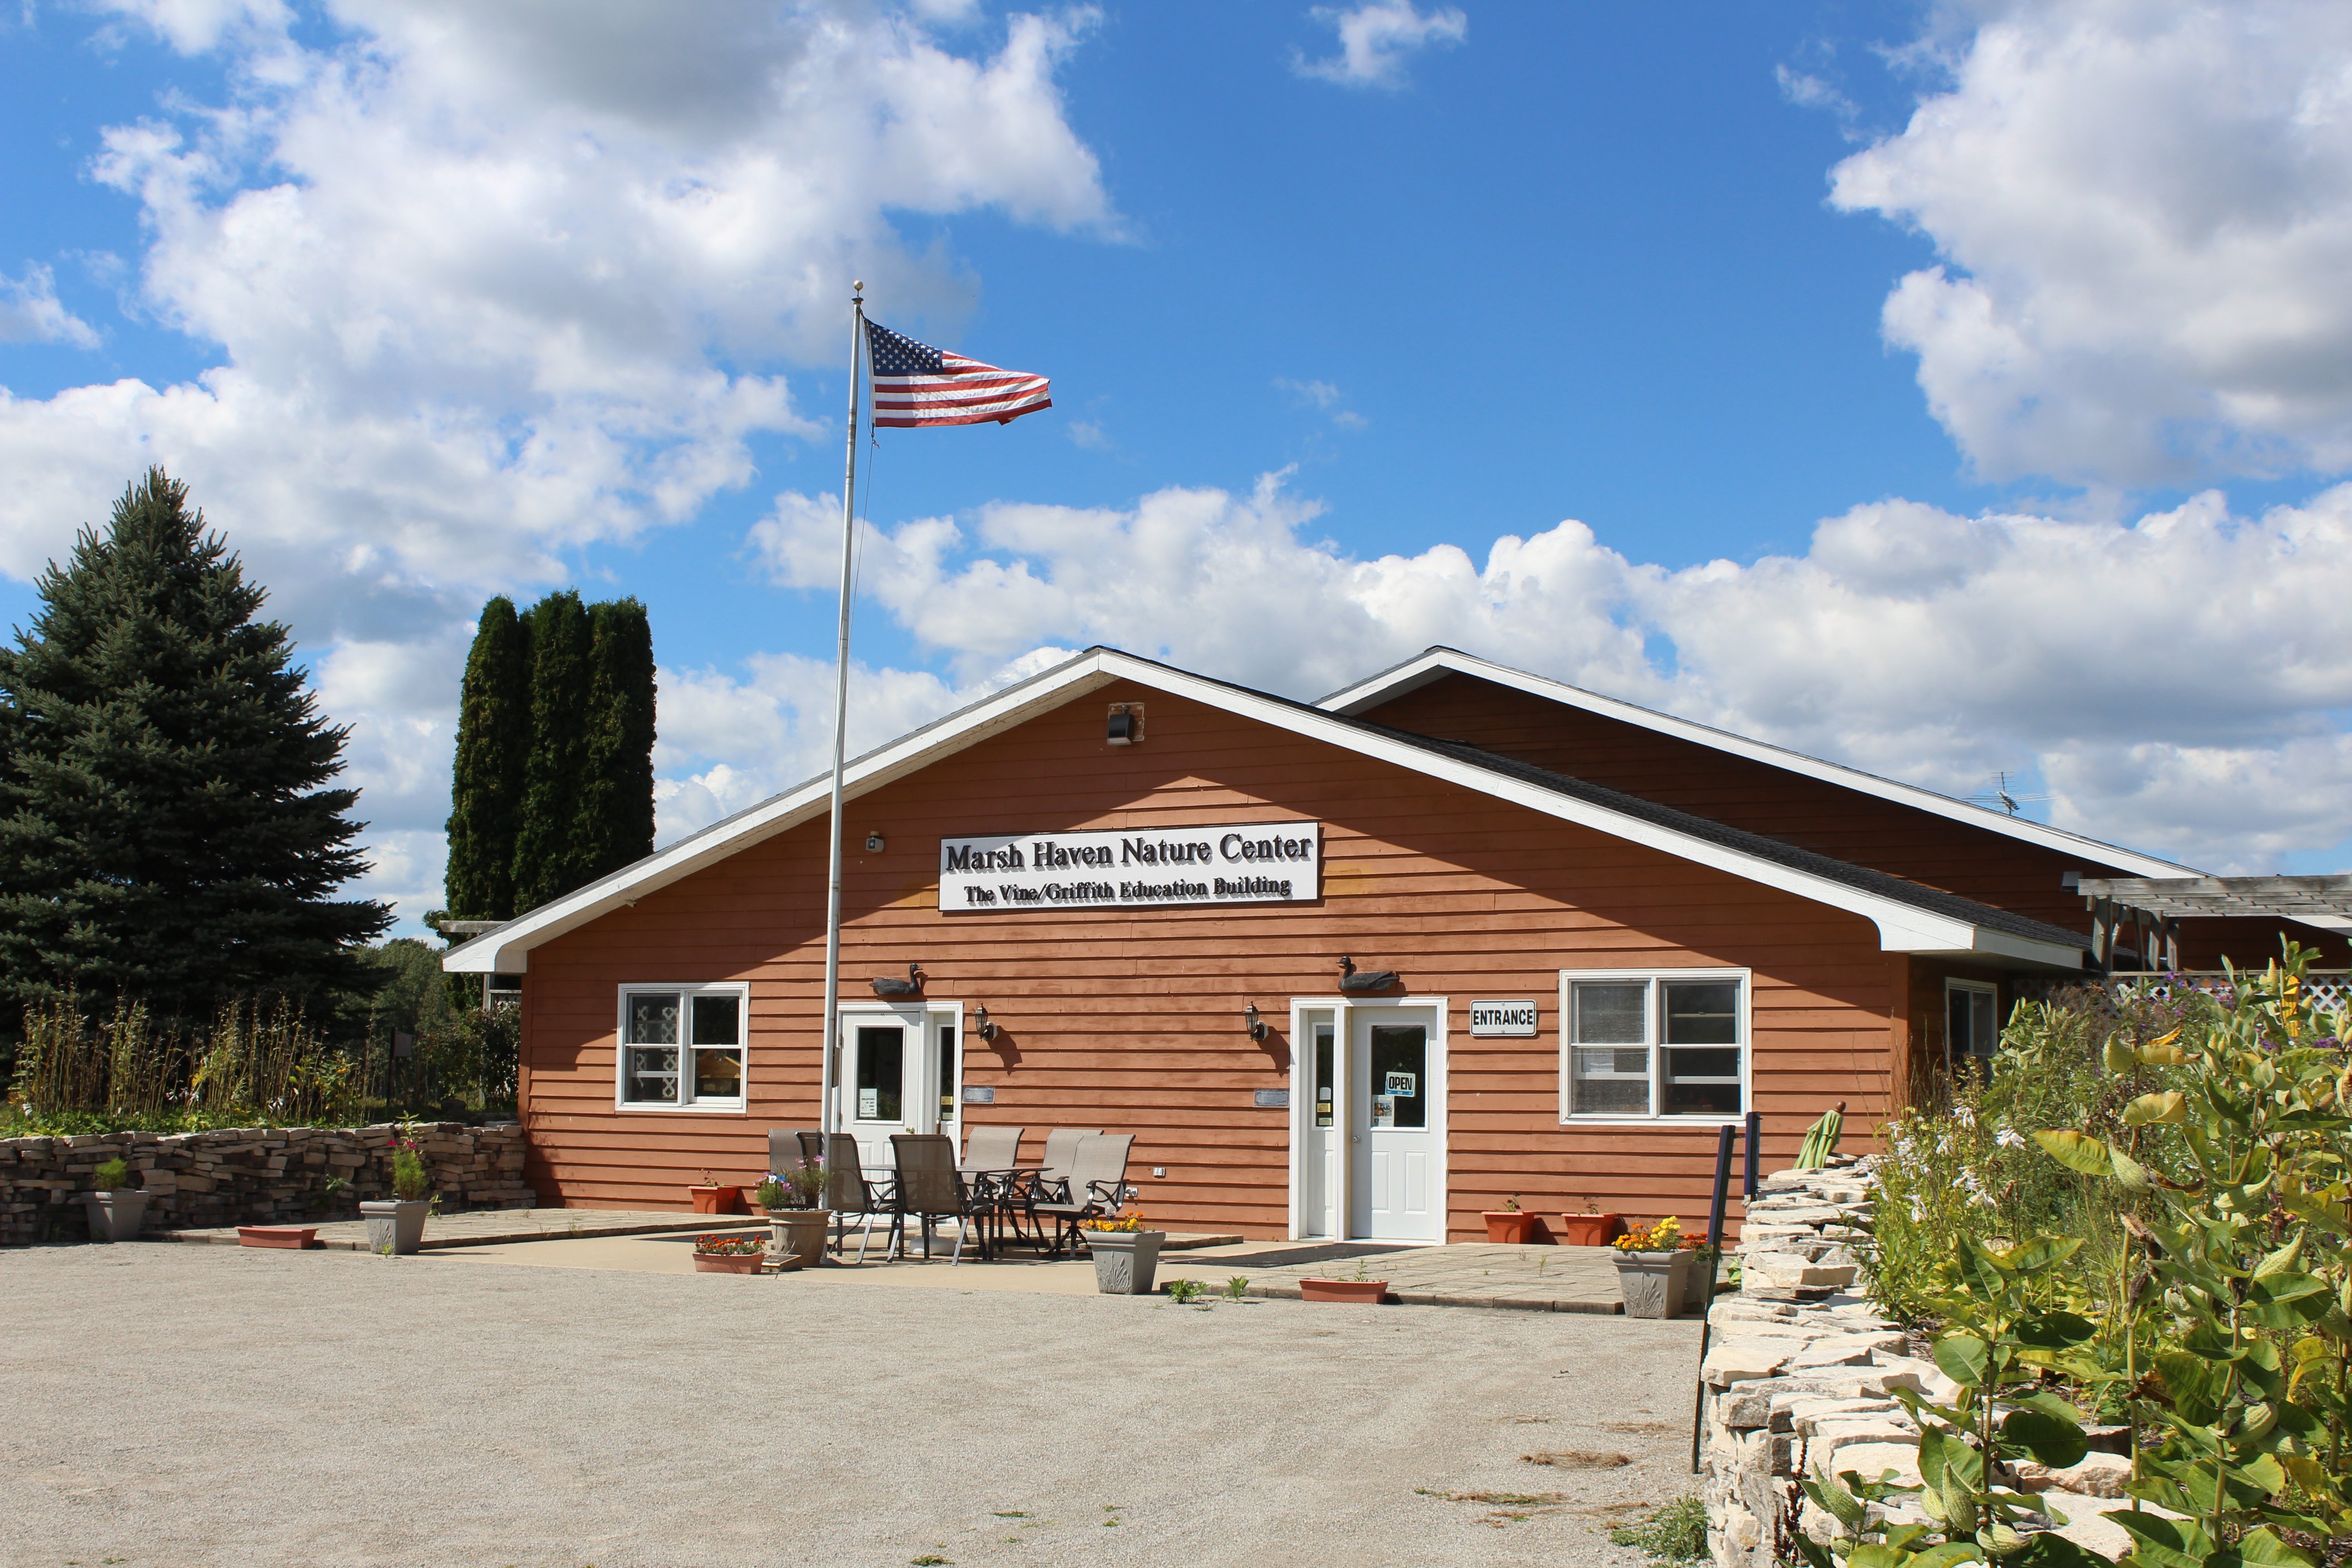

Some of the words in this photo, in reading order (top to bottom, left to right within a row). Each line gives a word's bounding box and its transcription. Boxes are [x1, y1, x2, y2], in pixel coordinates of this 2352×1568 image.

[946, 843, 1024, 871] Marsh
[1032, 841, 1112, 867] Haven
[1120, 837, 1211, 863] Nature
[1219, 833, 1311, 859] Center
[964, 885, 995, 902] The
[998, 881, 1113, 901] Vine/Griffith
[1119, 879, 1207, 898] Education
[1213, 876, 1291, 897] Building
[1473, 1009, 1533, 1025] ENTRANCE
[1388, 1076, 1412, 1090] OPEN
